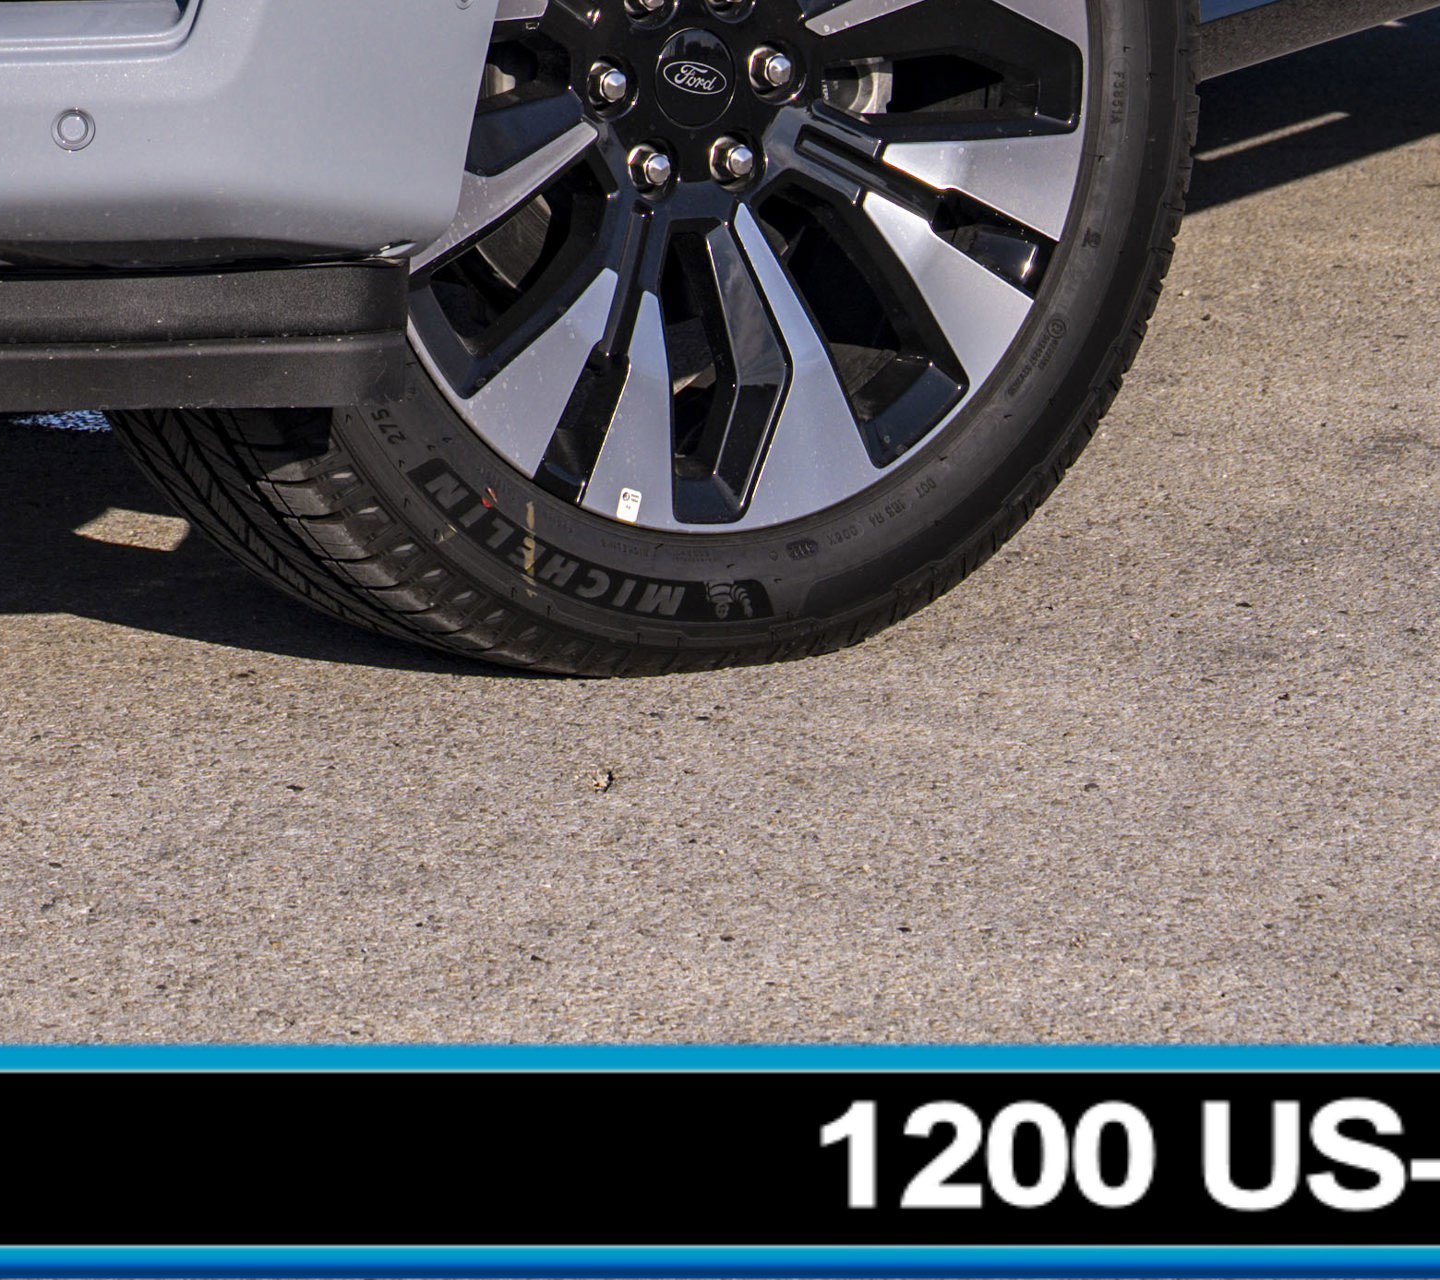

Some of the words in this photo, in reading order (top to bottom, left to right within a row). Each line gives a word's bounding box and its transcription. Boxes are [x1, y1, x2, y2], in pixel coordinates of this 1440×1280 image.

[673, 64, 717, 91] Ford
[371, 407, 407, 446] 275
[424, 471, 687, 617] MICHELIN
